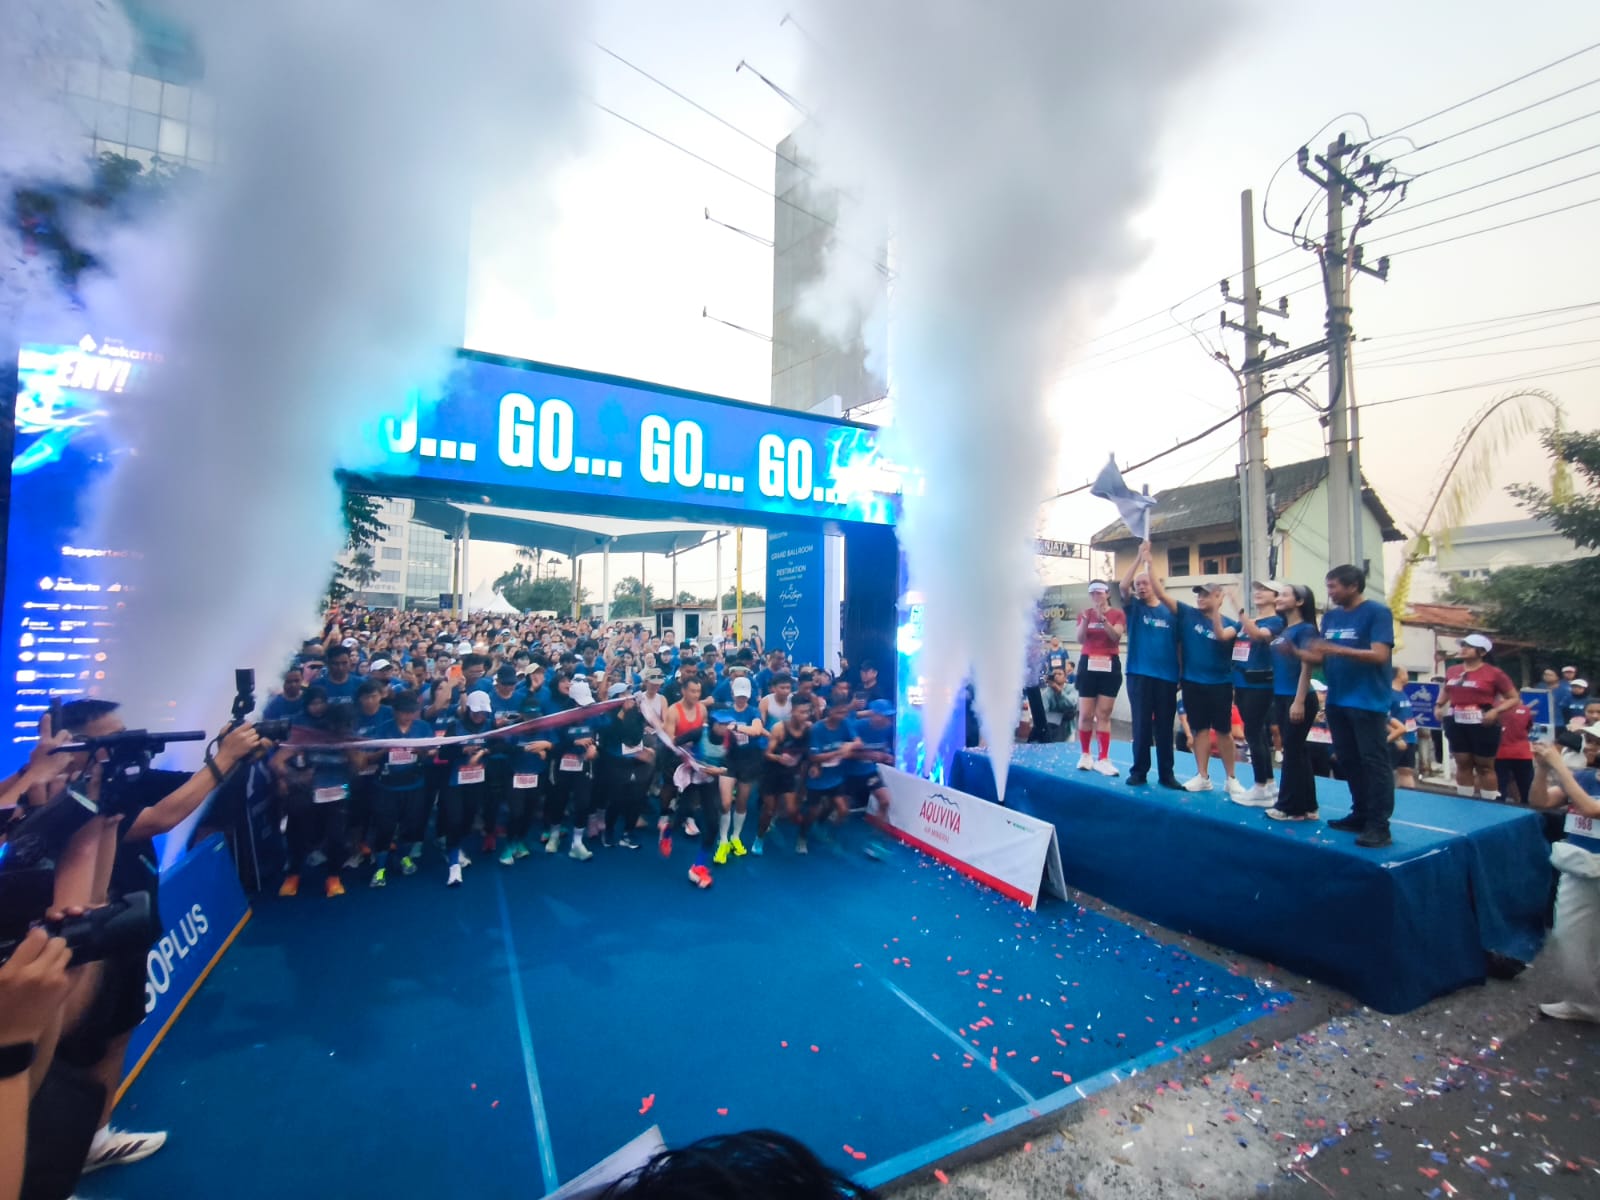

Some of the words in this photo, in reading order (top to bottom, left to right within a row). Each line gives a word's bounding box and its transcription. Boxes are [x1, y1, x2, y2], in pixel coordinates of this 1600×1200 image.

[497, 392, 622, 478] GO...
[639, 414, 745, 493] GO...
[919, 800, 961, 835] AQUVIVA
[139, 903, 210, 1025] OPLUS
